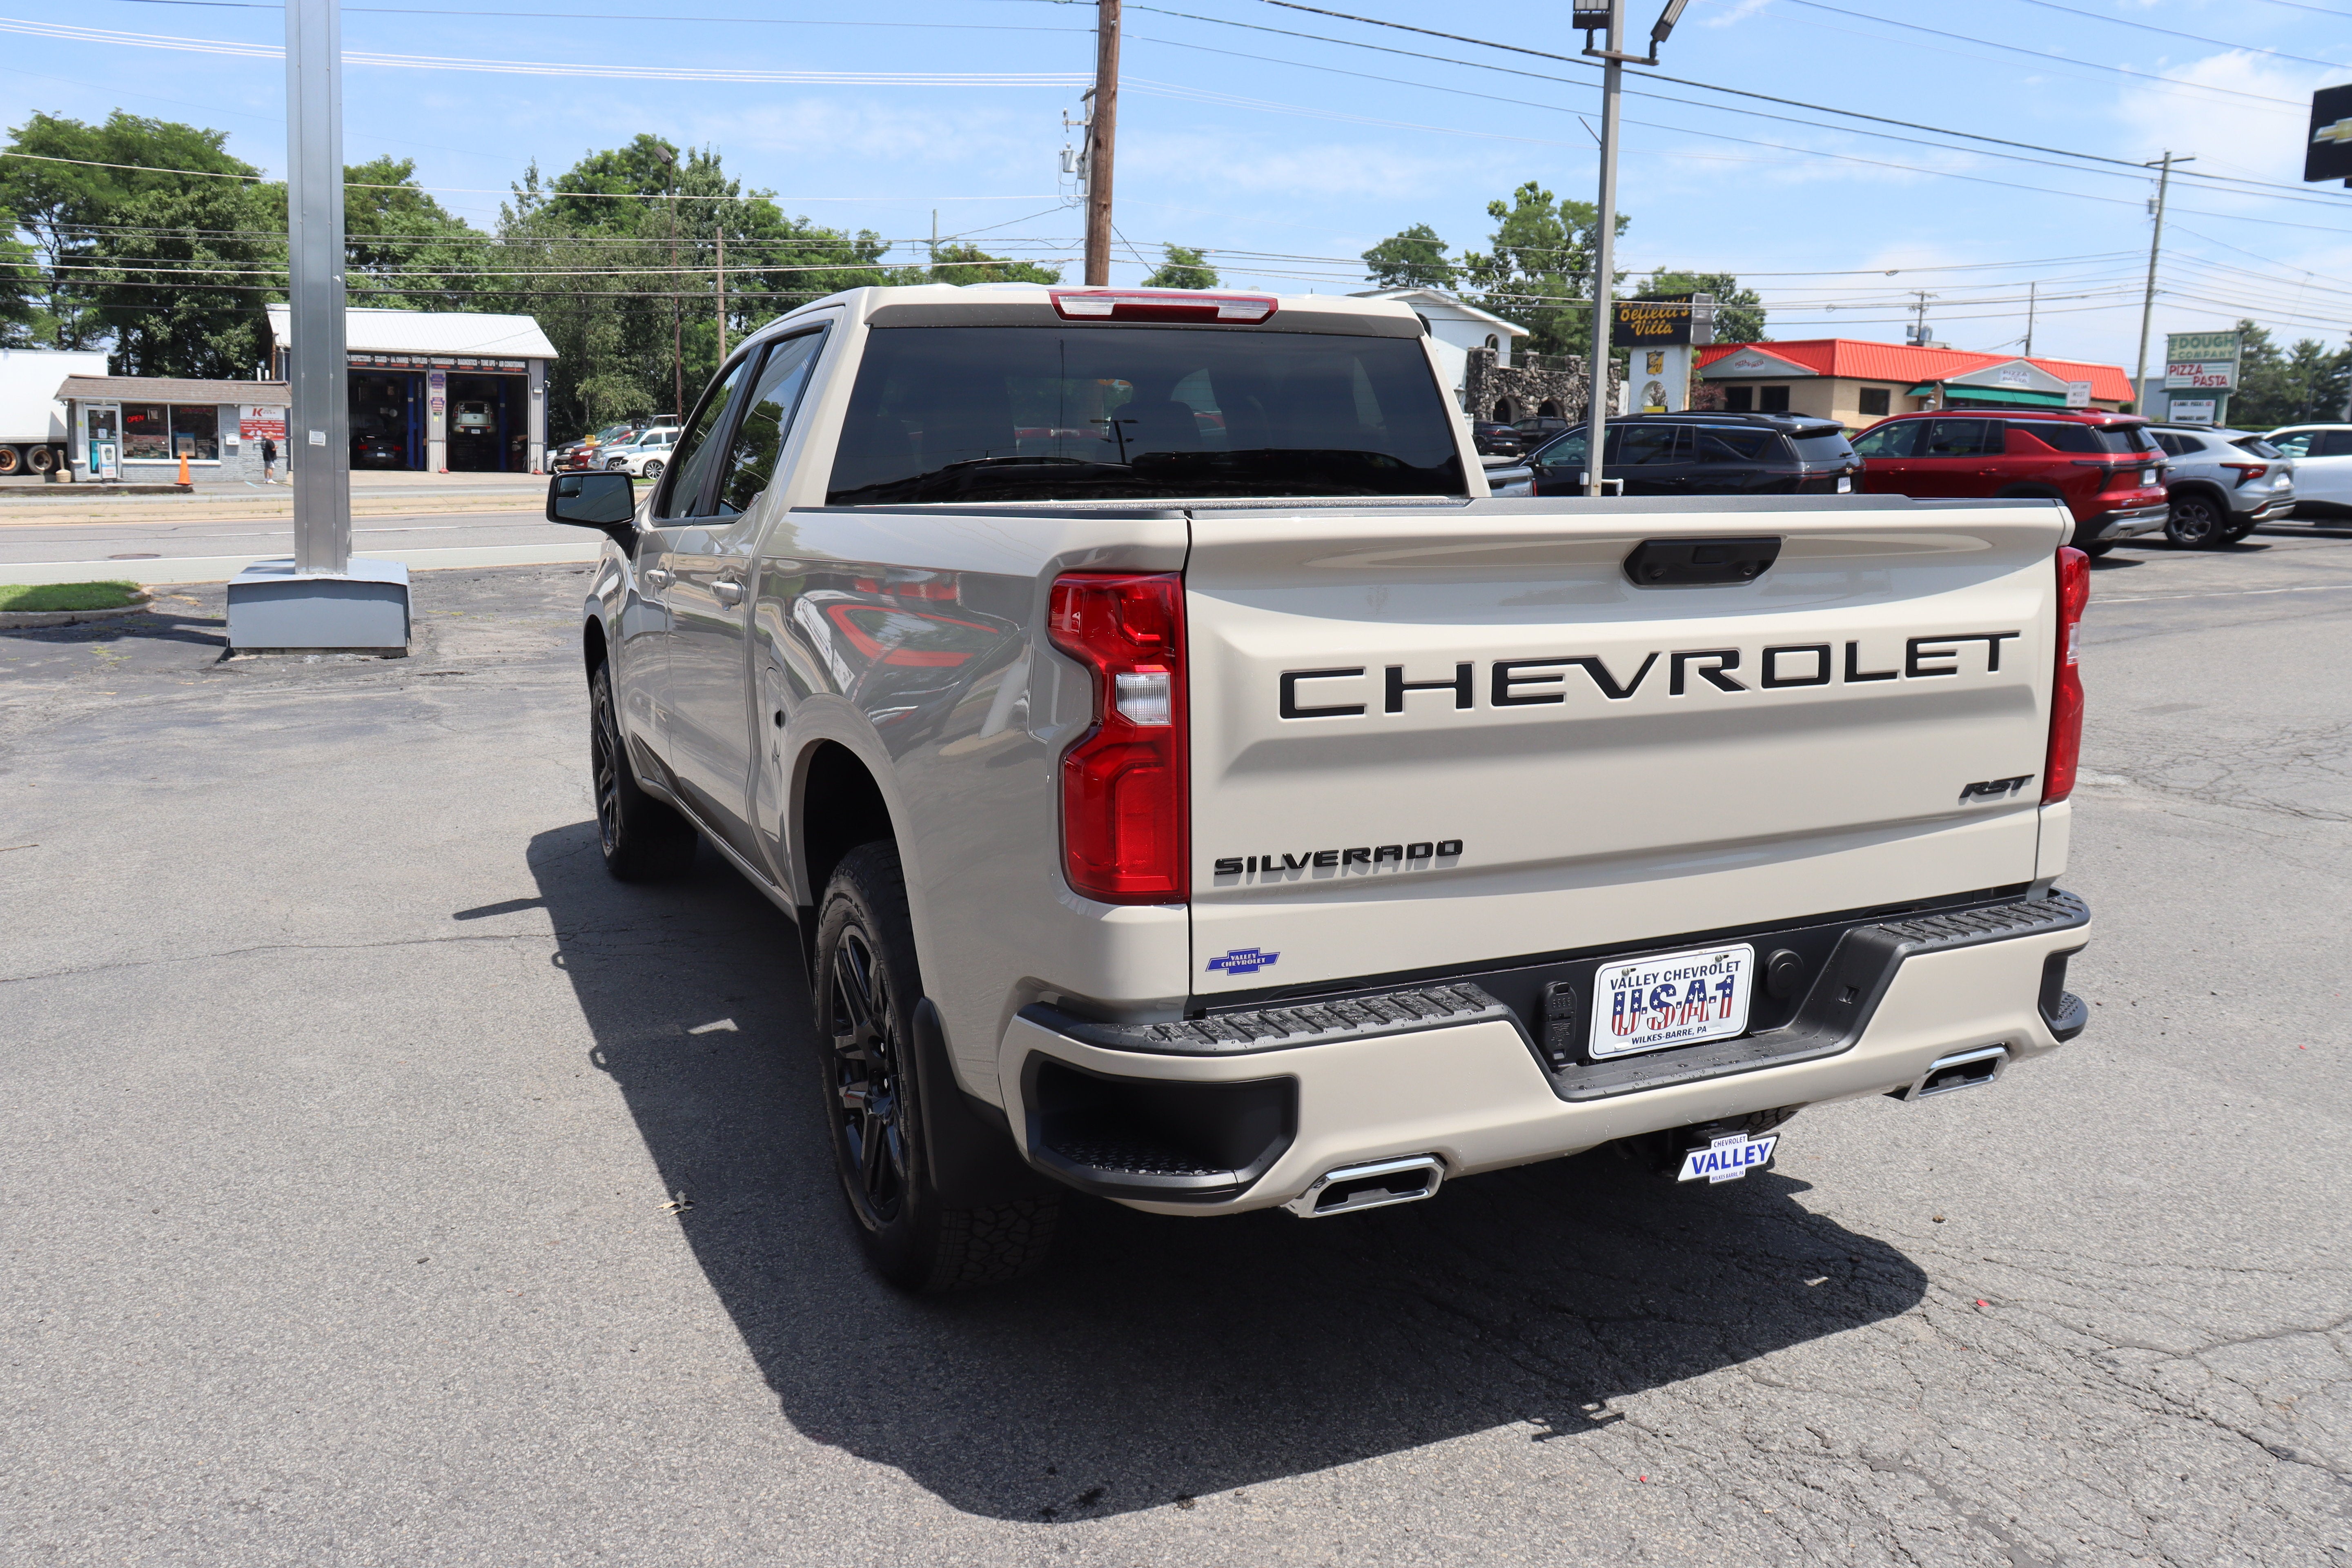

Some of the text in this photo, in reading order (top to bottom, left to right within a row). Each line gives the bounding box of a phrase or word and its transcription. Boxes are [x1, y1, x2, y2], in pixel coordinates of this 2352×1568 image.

[1631, 319, 1673, 336] Villa
[2179, 335, 2235, 349] DOUGH
[2178, 350, 2234, 359] COMPANY
[457, 358, 478, 366] DIAGNOSTICS
[2169, 364, 2203, 376] PIZZA
[2193, 375, 2228, 386] PASTA
[127, 415, 145, 423] OPEN
[1280, 632, 2021, 719] CHEVROLET
[1959, 774, 2035, 798] RST
[1215, 839, 1463, 875] SILVERADO
[1221, 958, 1266, 968] CHEVROLET
[1610, 960, 1741, 991] VALLEY CHEVROLET
[1631, 1026, 1707, 1045] WILKES-BARRE, PA
[1713, 1136, 1746, 1148] CHEVROLET
[1691, 1142, 1770, 1175] VALLEY
